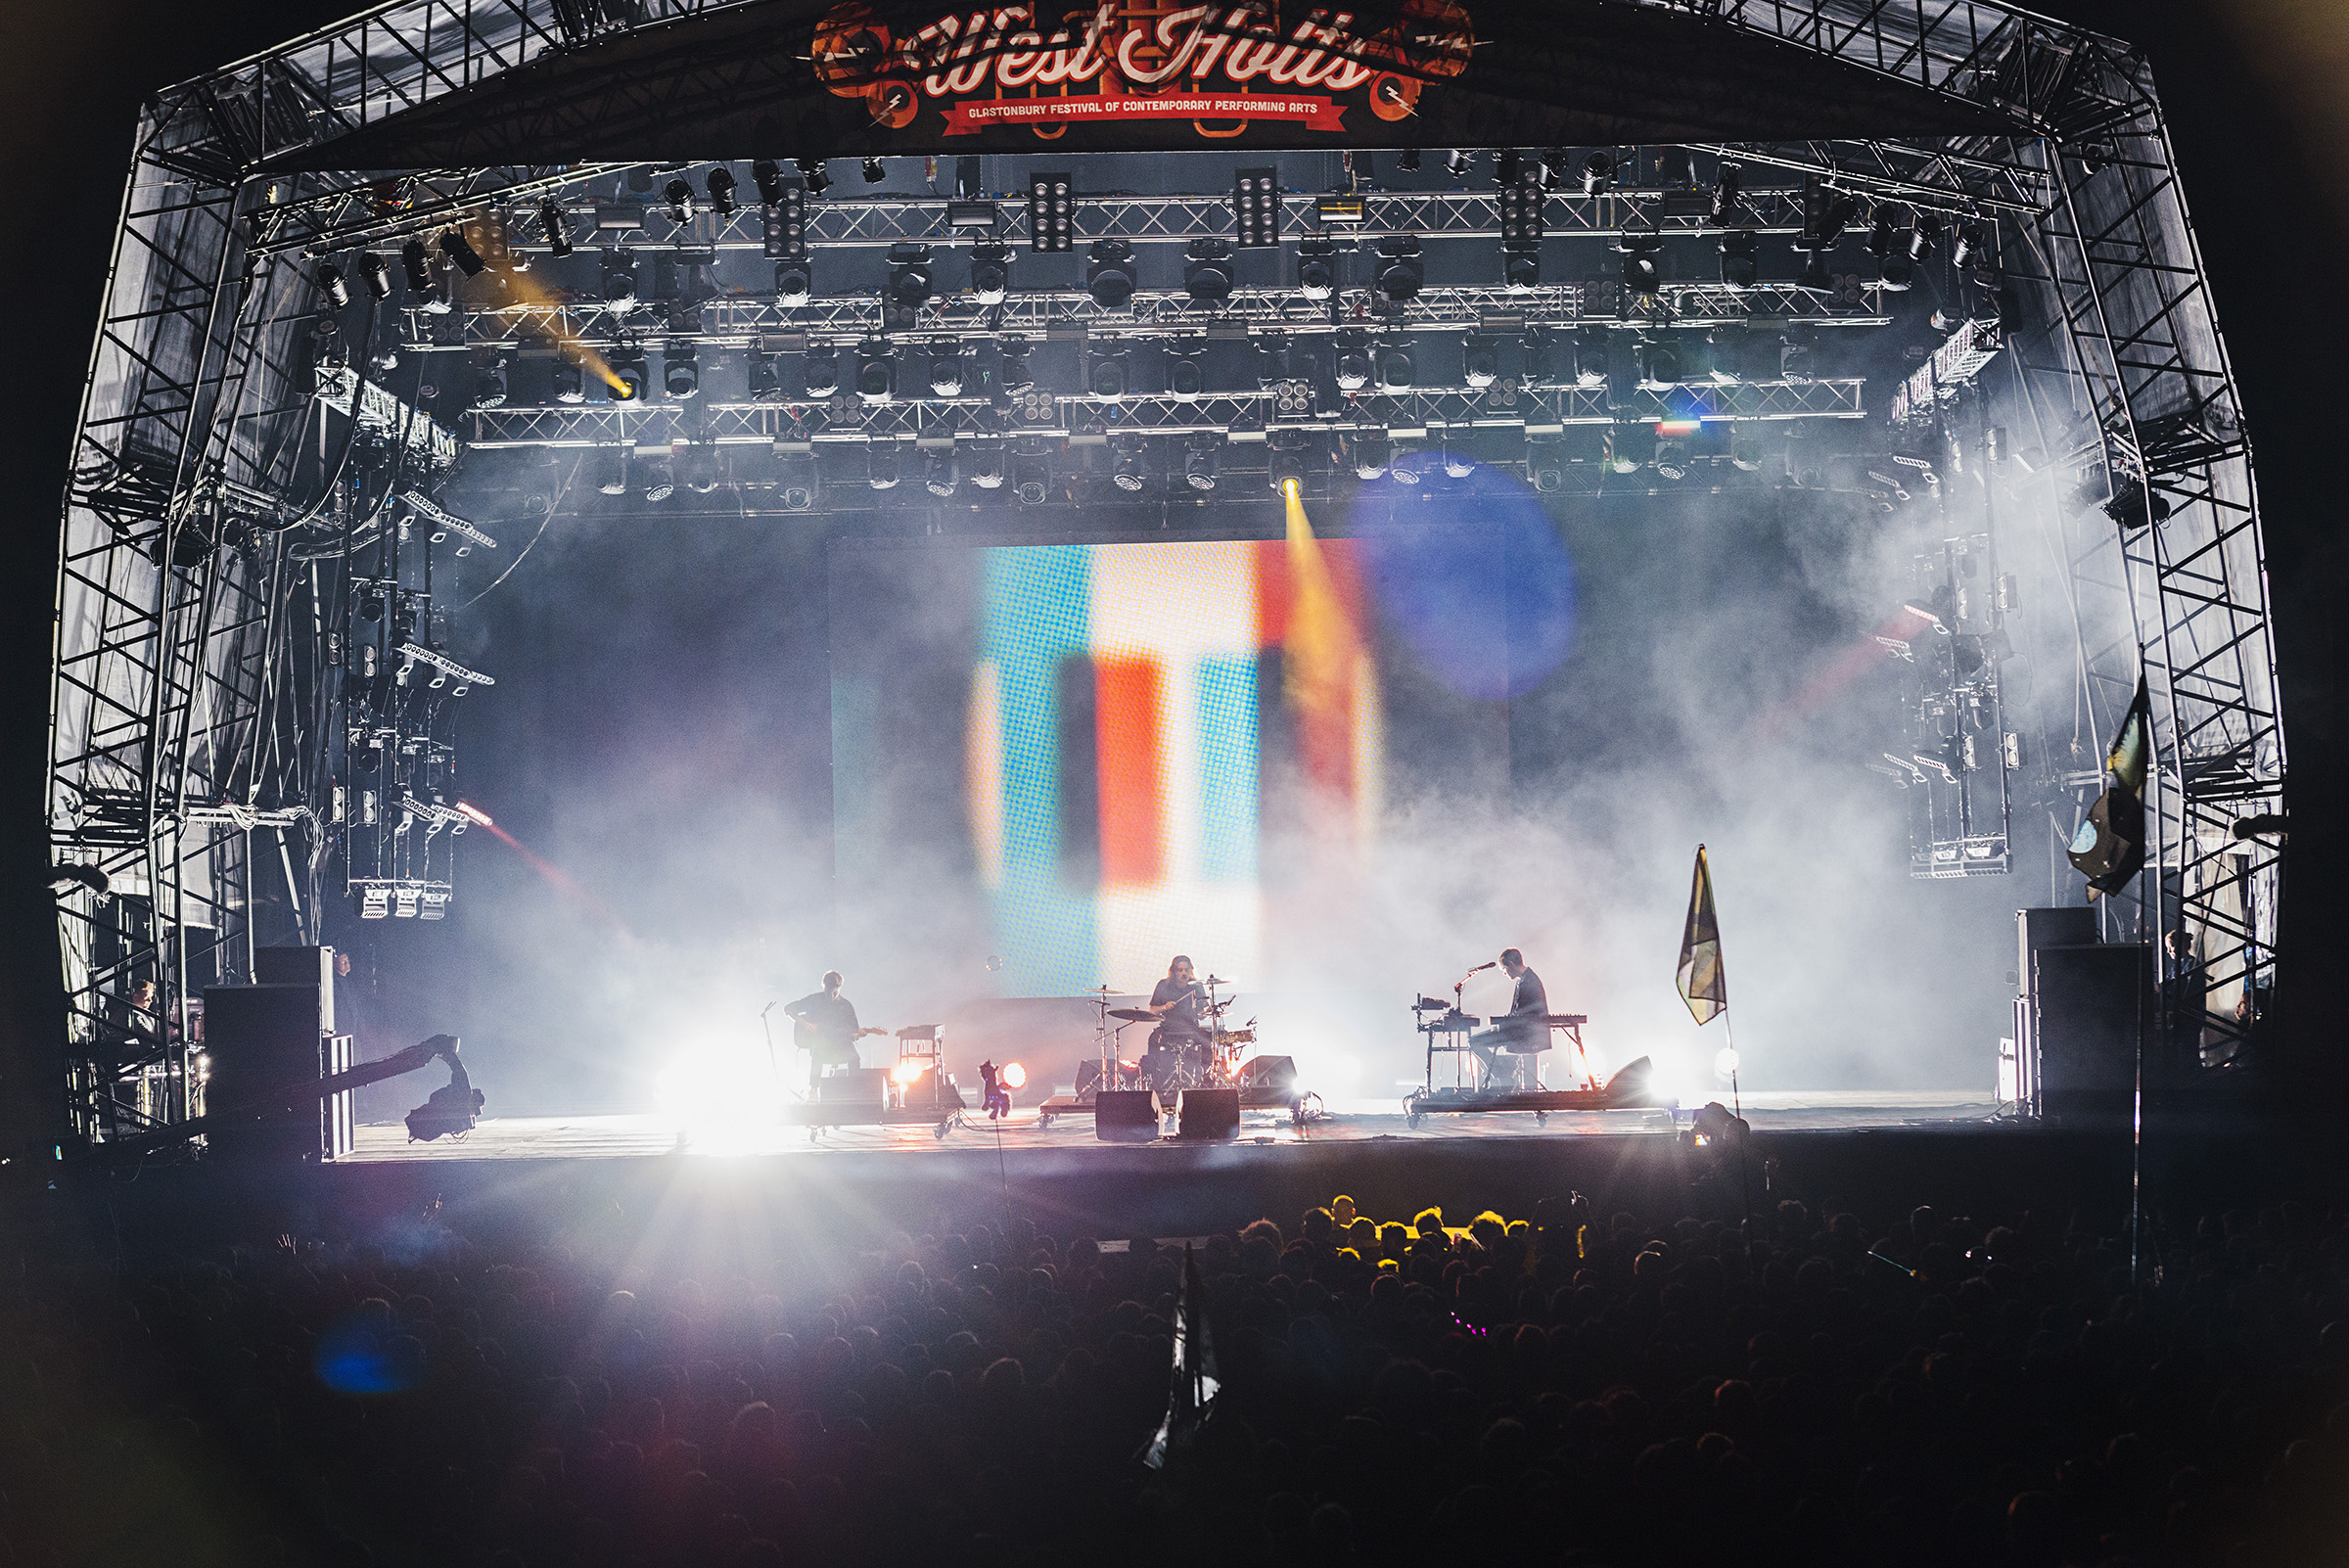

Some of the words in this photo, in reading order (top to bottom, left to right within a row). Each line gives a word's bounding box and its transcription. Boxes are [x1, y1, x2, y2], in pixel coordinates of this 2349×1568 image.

[902, 4, 1116, 96] West
[1118, 3, 1370, 88] Holts
[968, 105, 1046, 118] GLASTONBURY
[1050, 102, 1102, 115] FESTIVAL
[1105, 101, 1120, 113] OF
[1123, 100, 1212, 112] CONTEMPORARY
[1215, 101, 1286, 113] PERFORMING
[1289, 102, 1317, 114] ARTS
